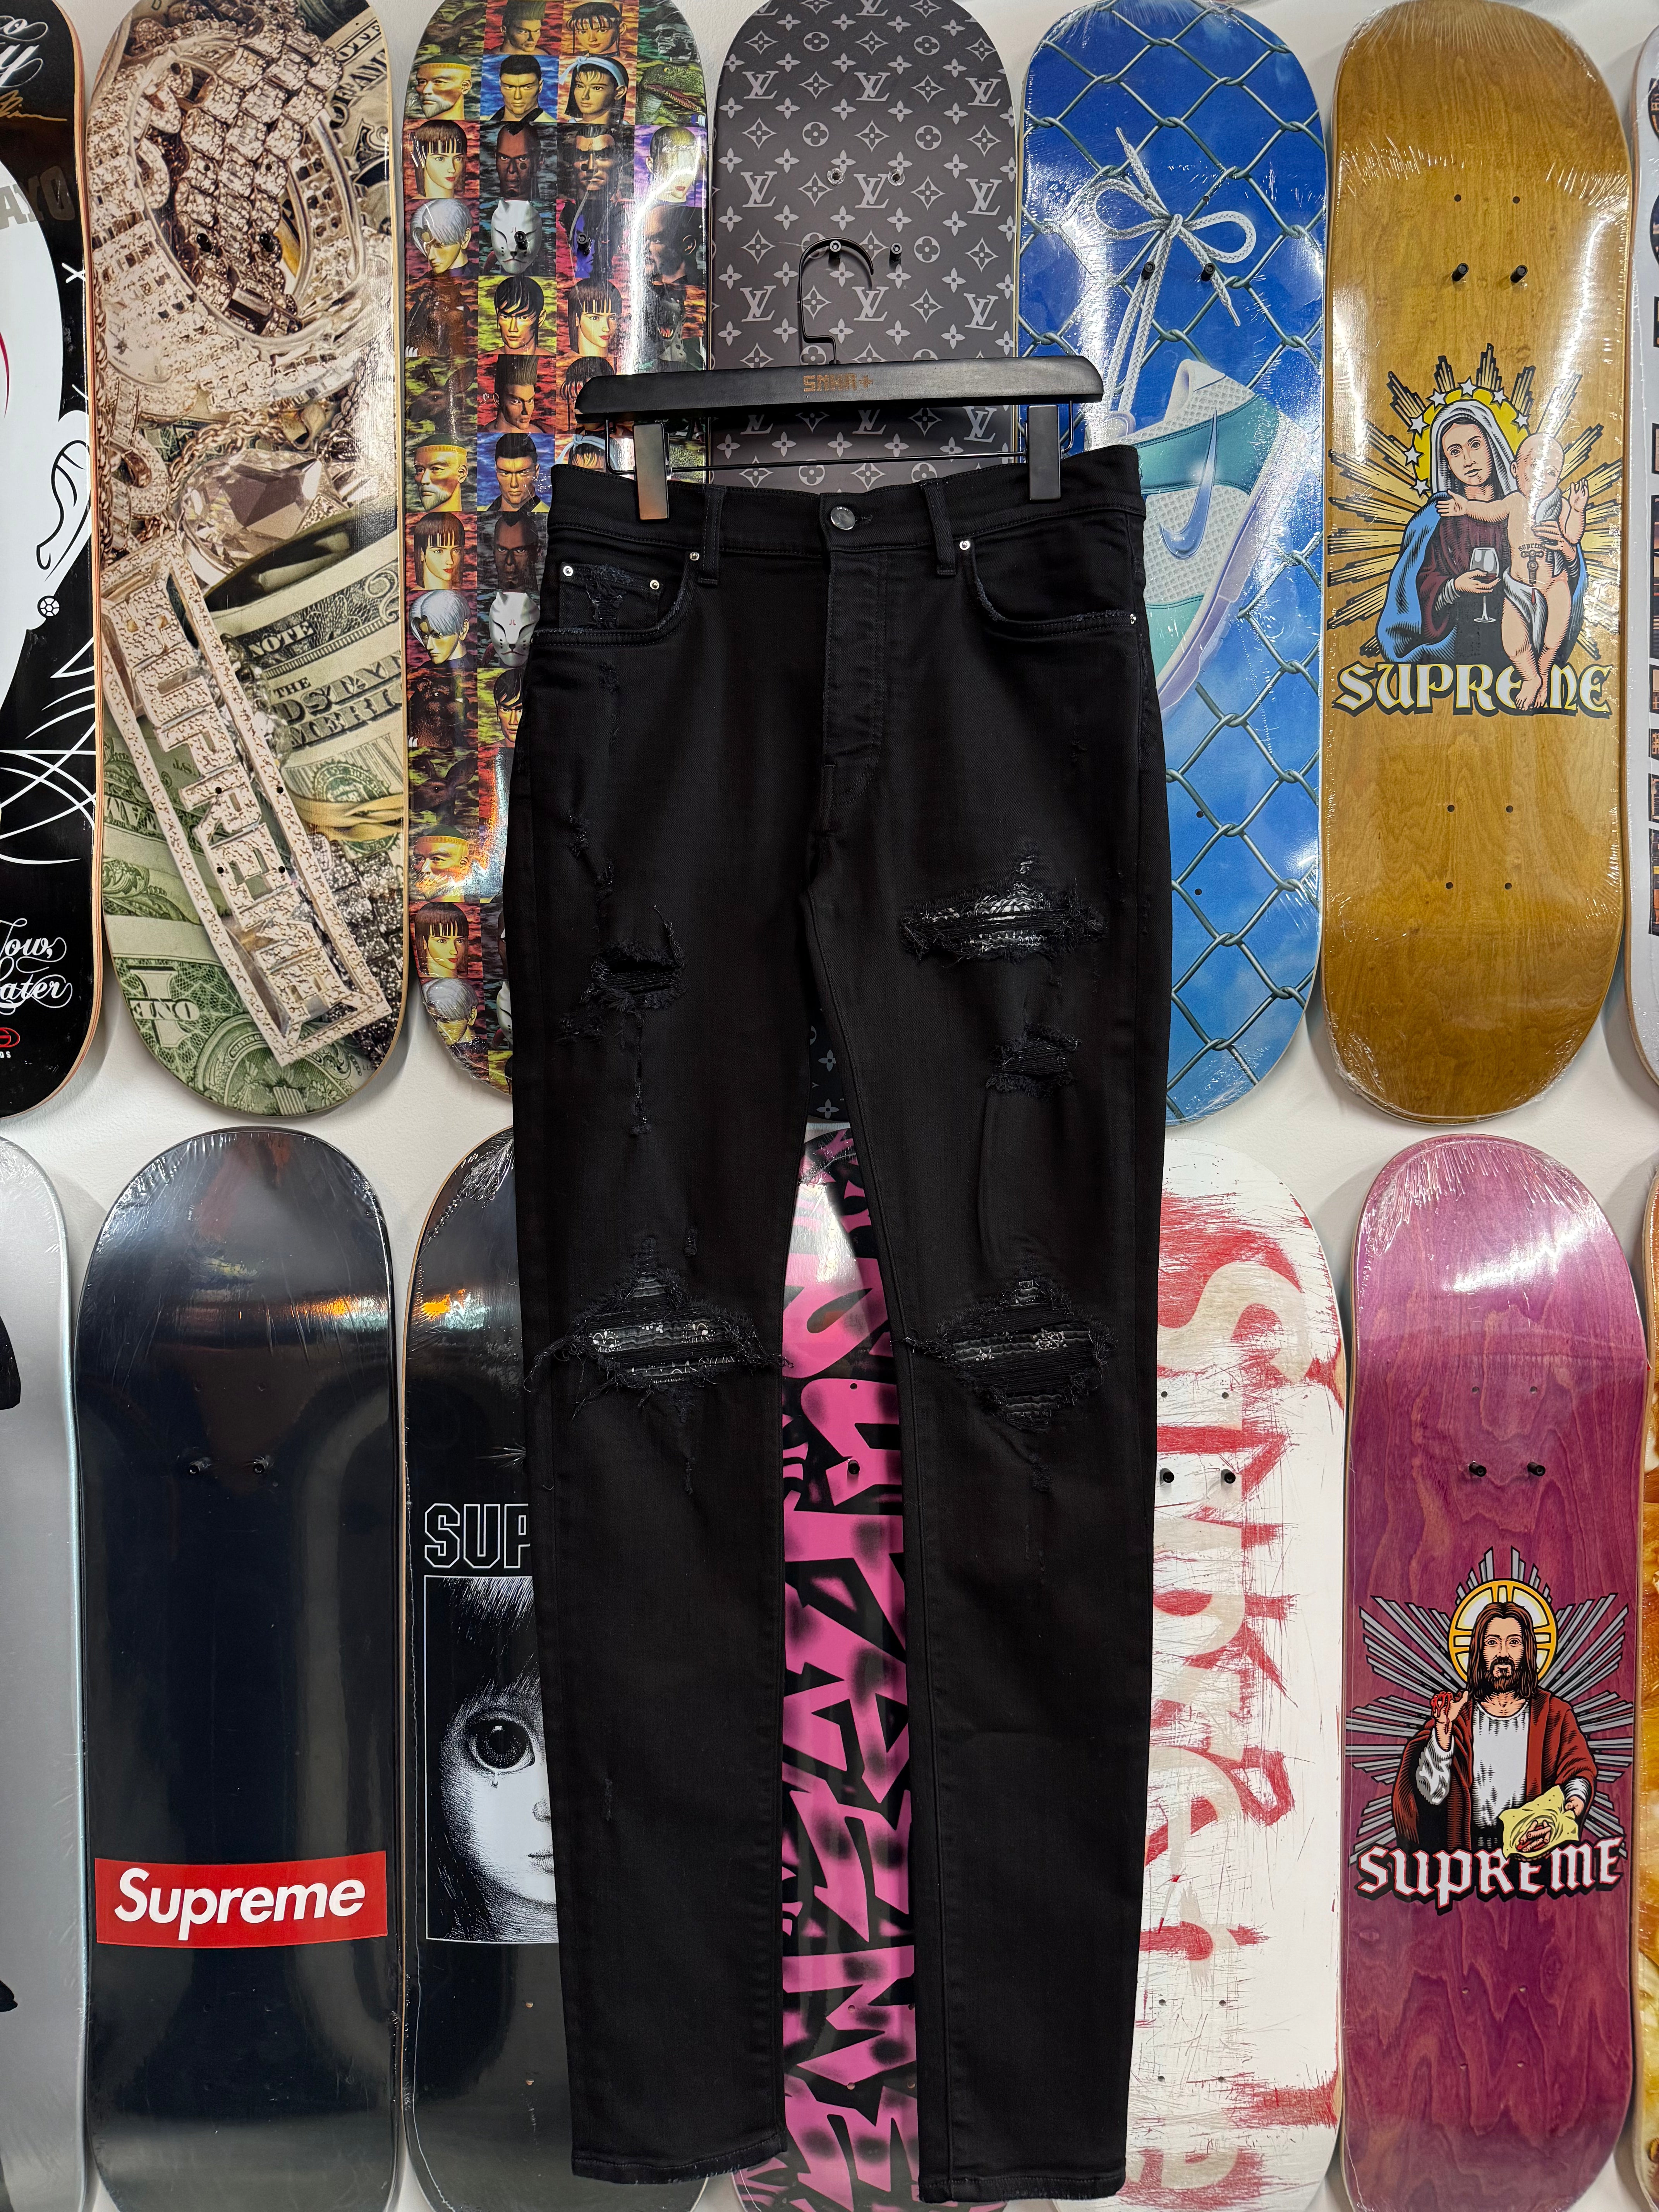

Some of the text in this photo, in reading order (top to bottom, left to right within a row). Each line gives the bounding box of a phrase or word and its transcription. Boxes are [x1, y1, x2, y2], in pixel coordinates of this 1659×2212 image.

[248, 621, 314, 658] NOTE
[273, 677, 311, 698] THE
[130, 999, 200, 1020] ONE
[114, 1867, 366, 1941] Supreme
